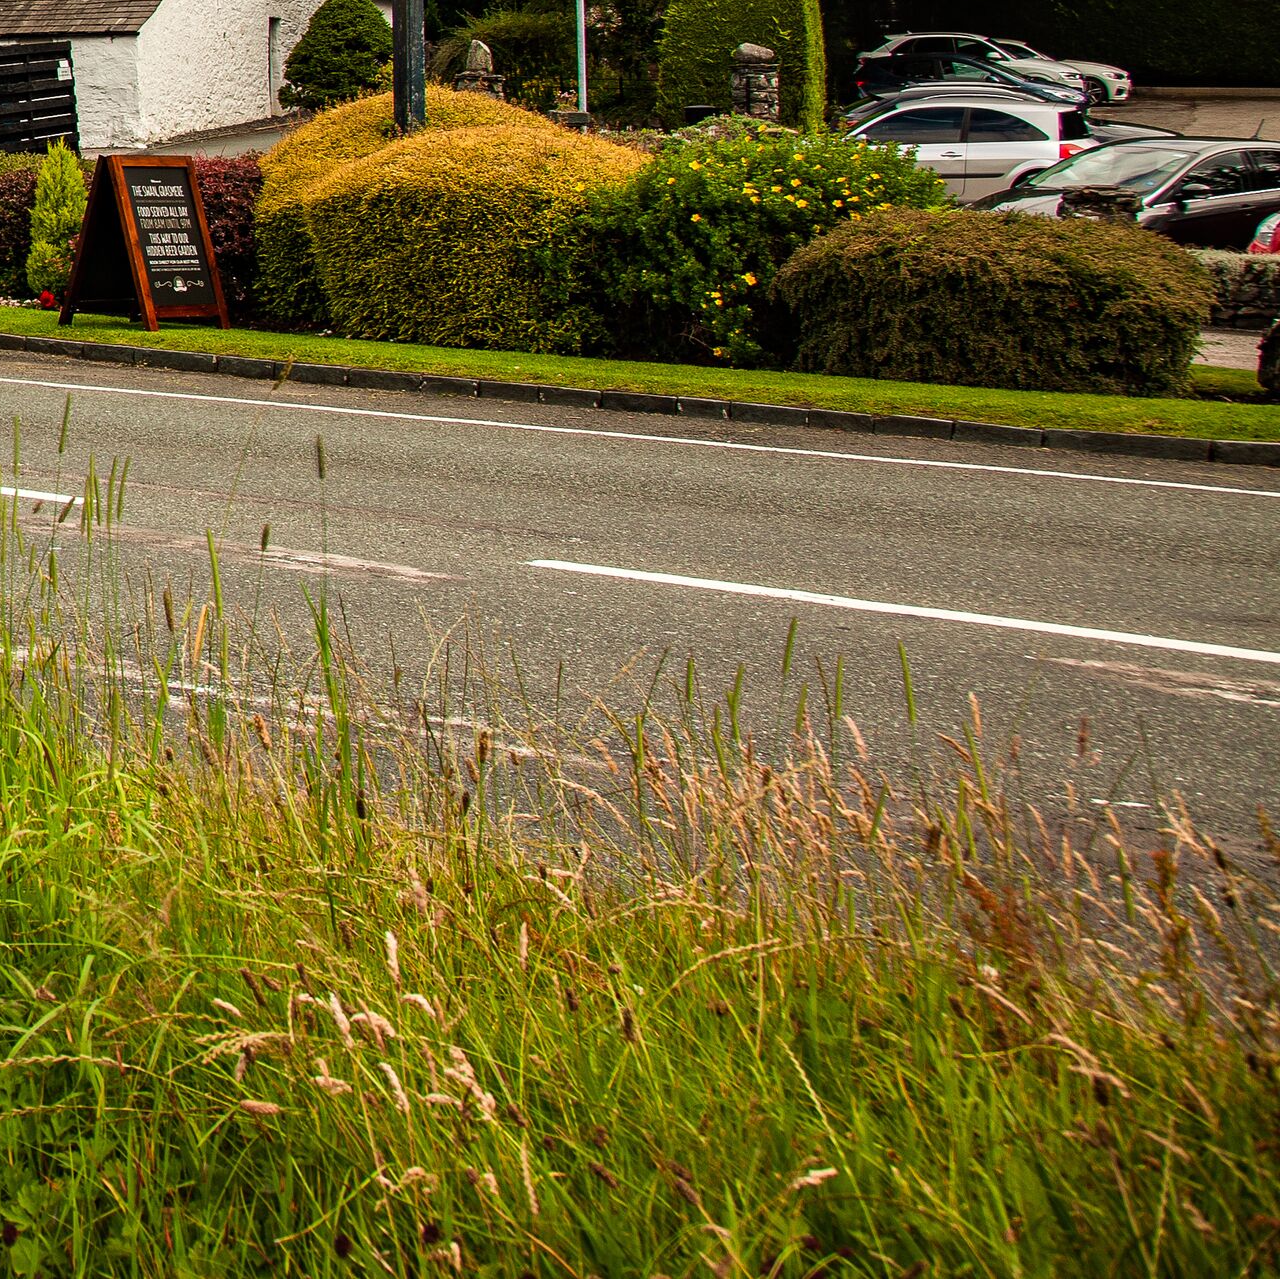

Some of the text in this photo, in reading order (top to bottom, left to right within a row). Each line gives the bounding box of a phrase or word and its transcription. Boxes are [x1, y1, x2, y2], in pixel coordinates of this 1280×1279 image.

[131, 185, 143, 197] THE
[158, 185, 184, 197] GRASMERE
[137, 206, 188, 217] FOOD SERVED ALL DAY
[140, 218, 155, 228] FROM
[165, 218, 180, 228] UNTIL
[149, 233, 190, 244] THIS WAY TO OUR
[146, 245, 198, 256] HIDDEN BEER GARDEN
